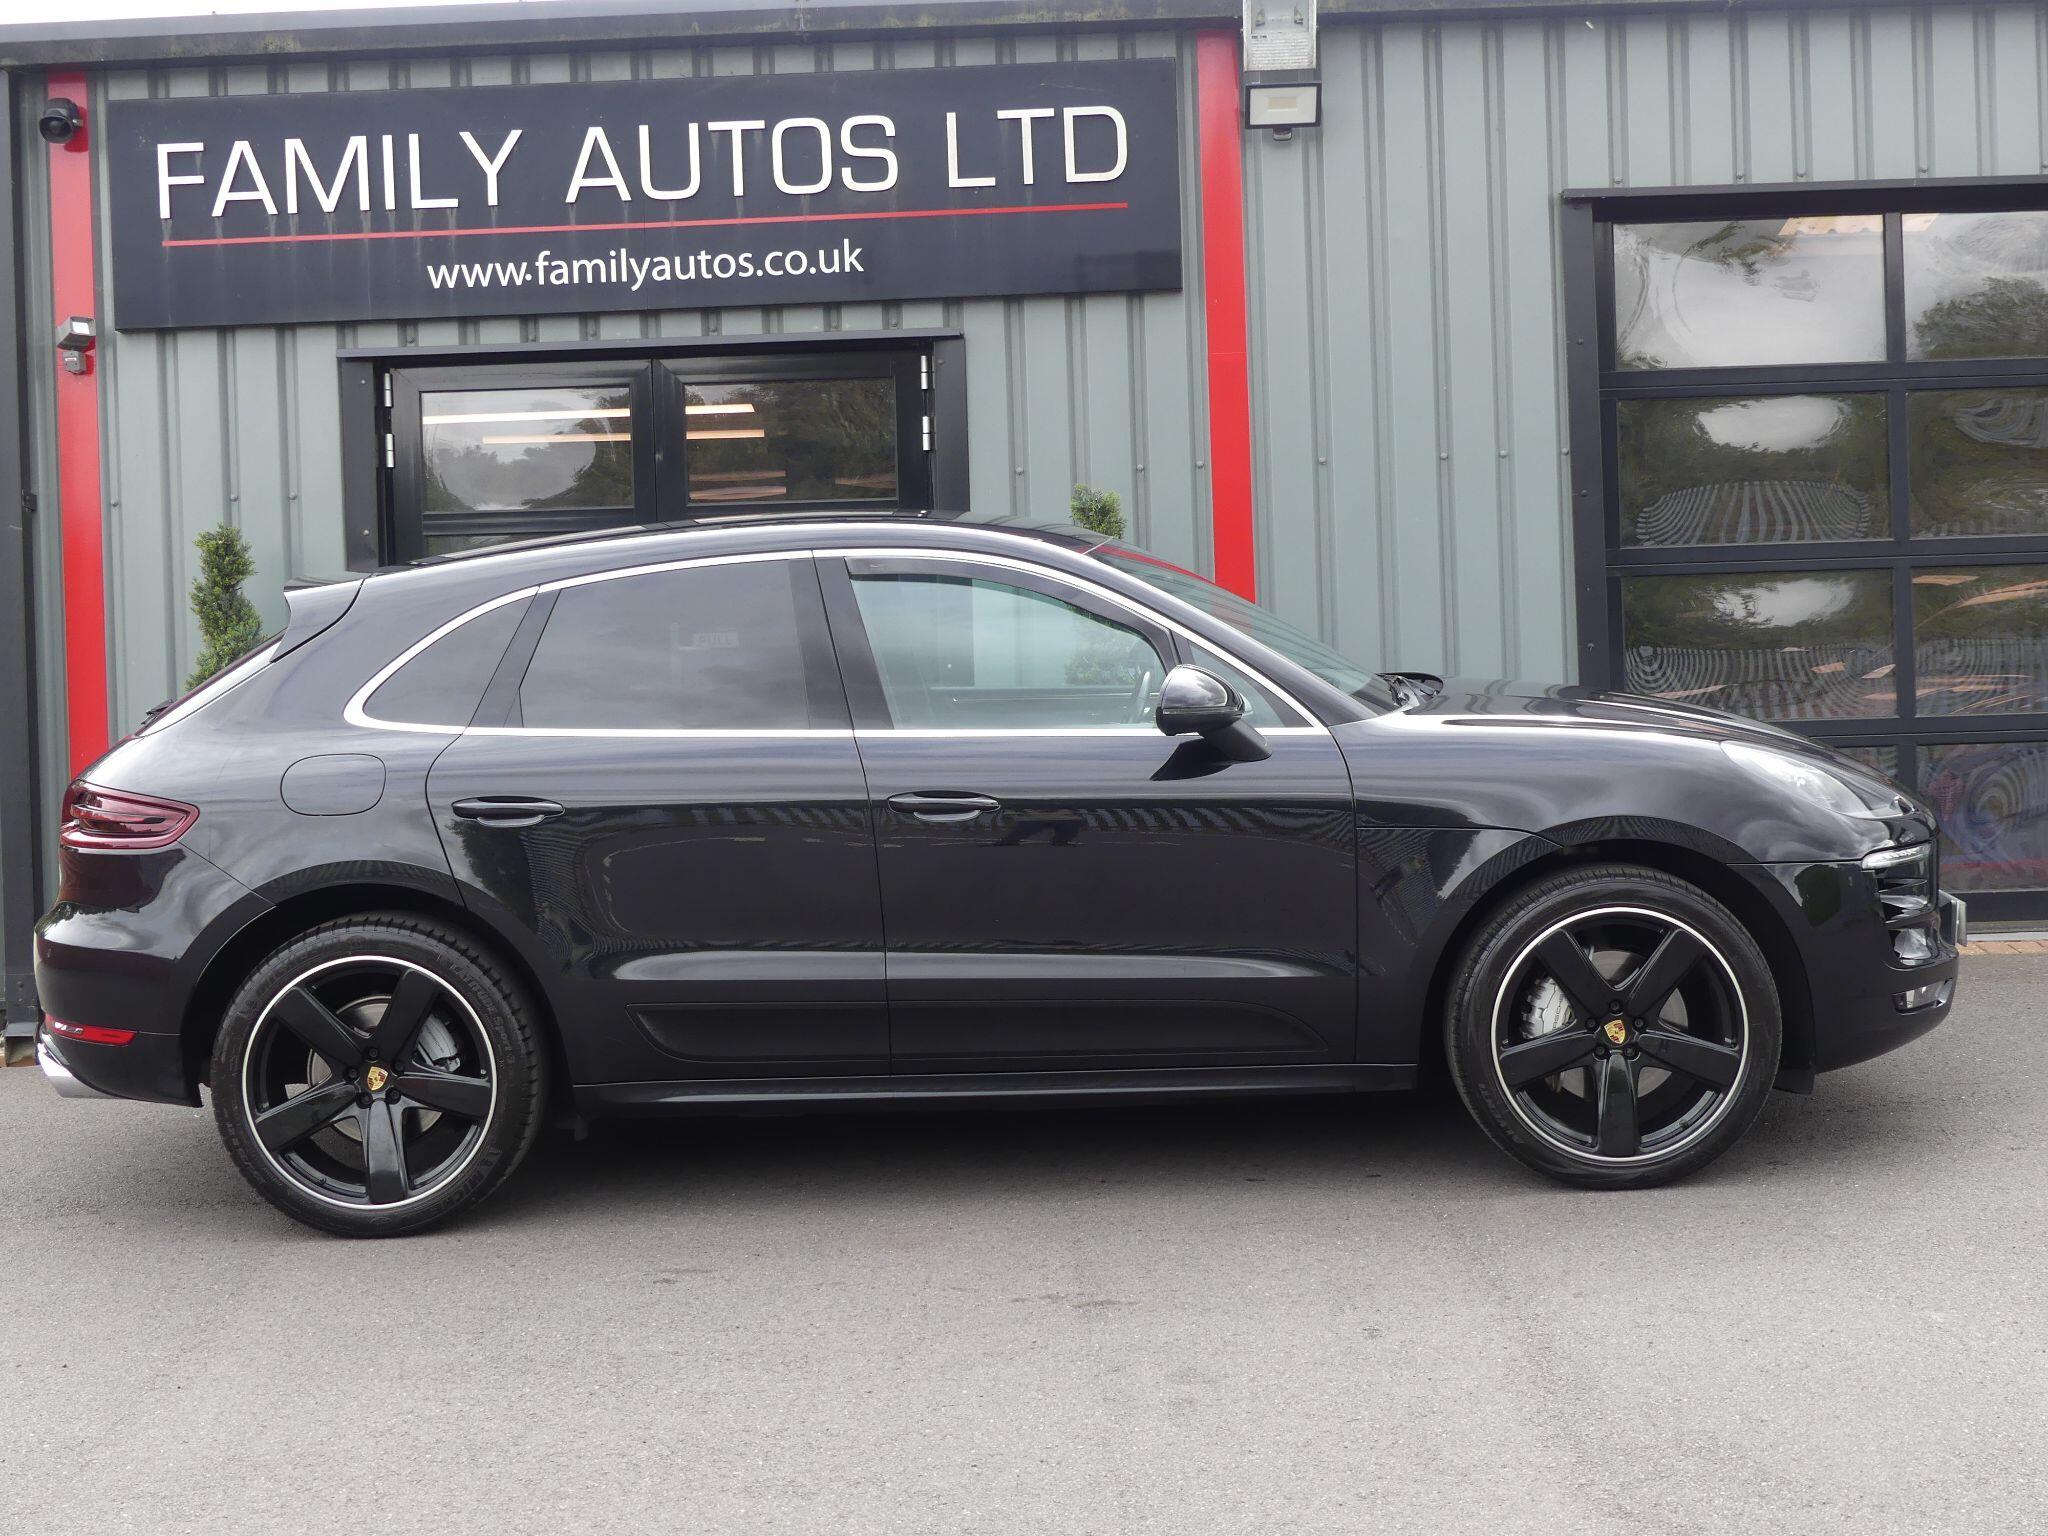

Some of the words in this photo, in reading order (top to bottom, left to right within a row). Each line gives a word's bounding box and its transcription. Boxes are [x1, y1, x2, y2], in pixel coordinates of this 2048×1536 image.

[156, 129, 523, 220] FAMILY
[564, 114, 899, 206] AUTOS
[946, 105, 1128, 188] LTD
[426, 238, 865, 292] www.familyautos.co.uk
